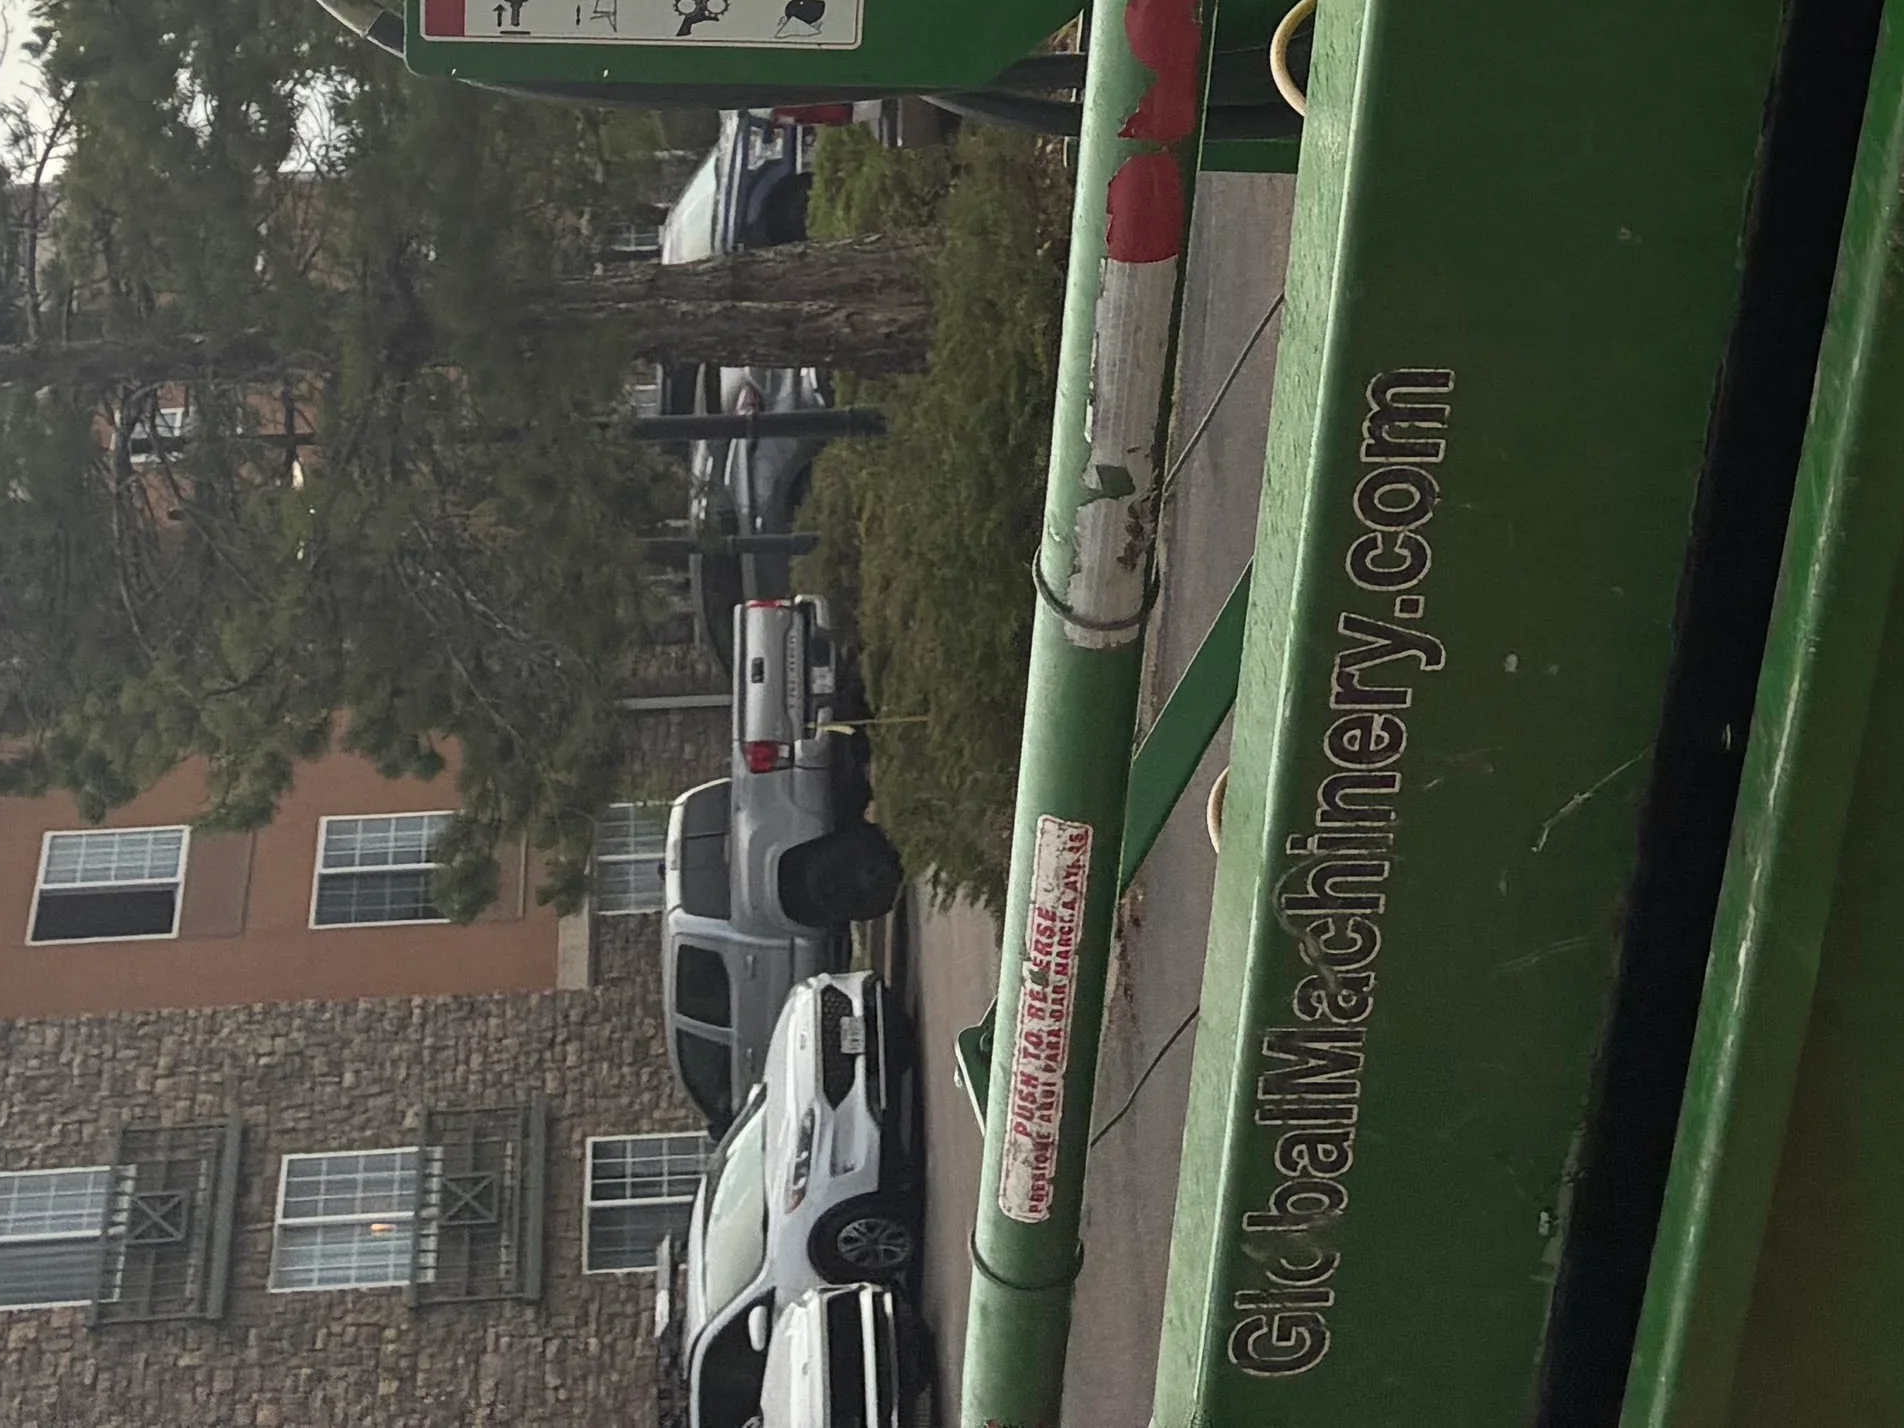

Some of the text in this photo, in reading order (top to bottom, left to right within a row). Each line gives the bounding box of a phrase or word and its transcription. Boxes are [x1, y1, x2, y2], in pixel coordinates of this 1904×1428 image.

[1013, 905, 1056, 1138] PUSH TO REERSE
[1043, 1028, 1062, 1073] PARA
[1039, 1082, 1056, 1124] AQUI
[1028, 1132, 1052, 1213] PRESIONE
